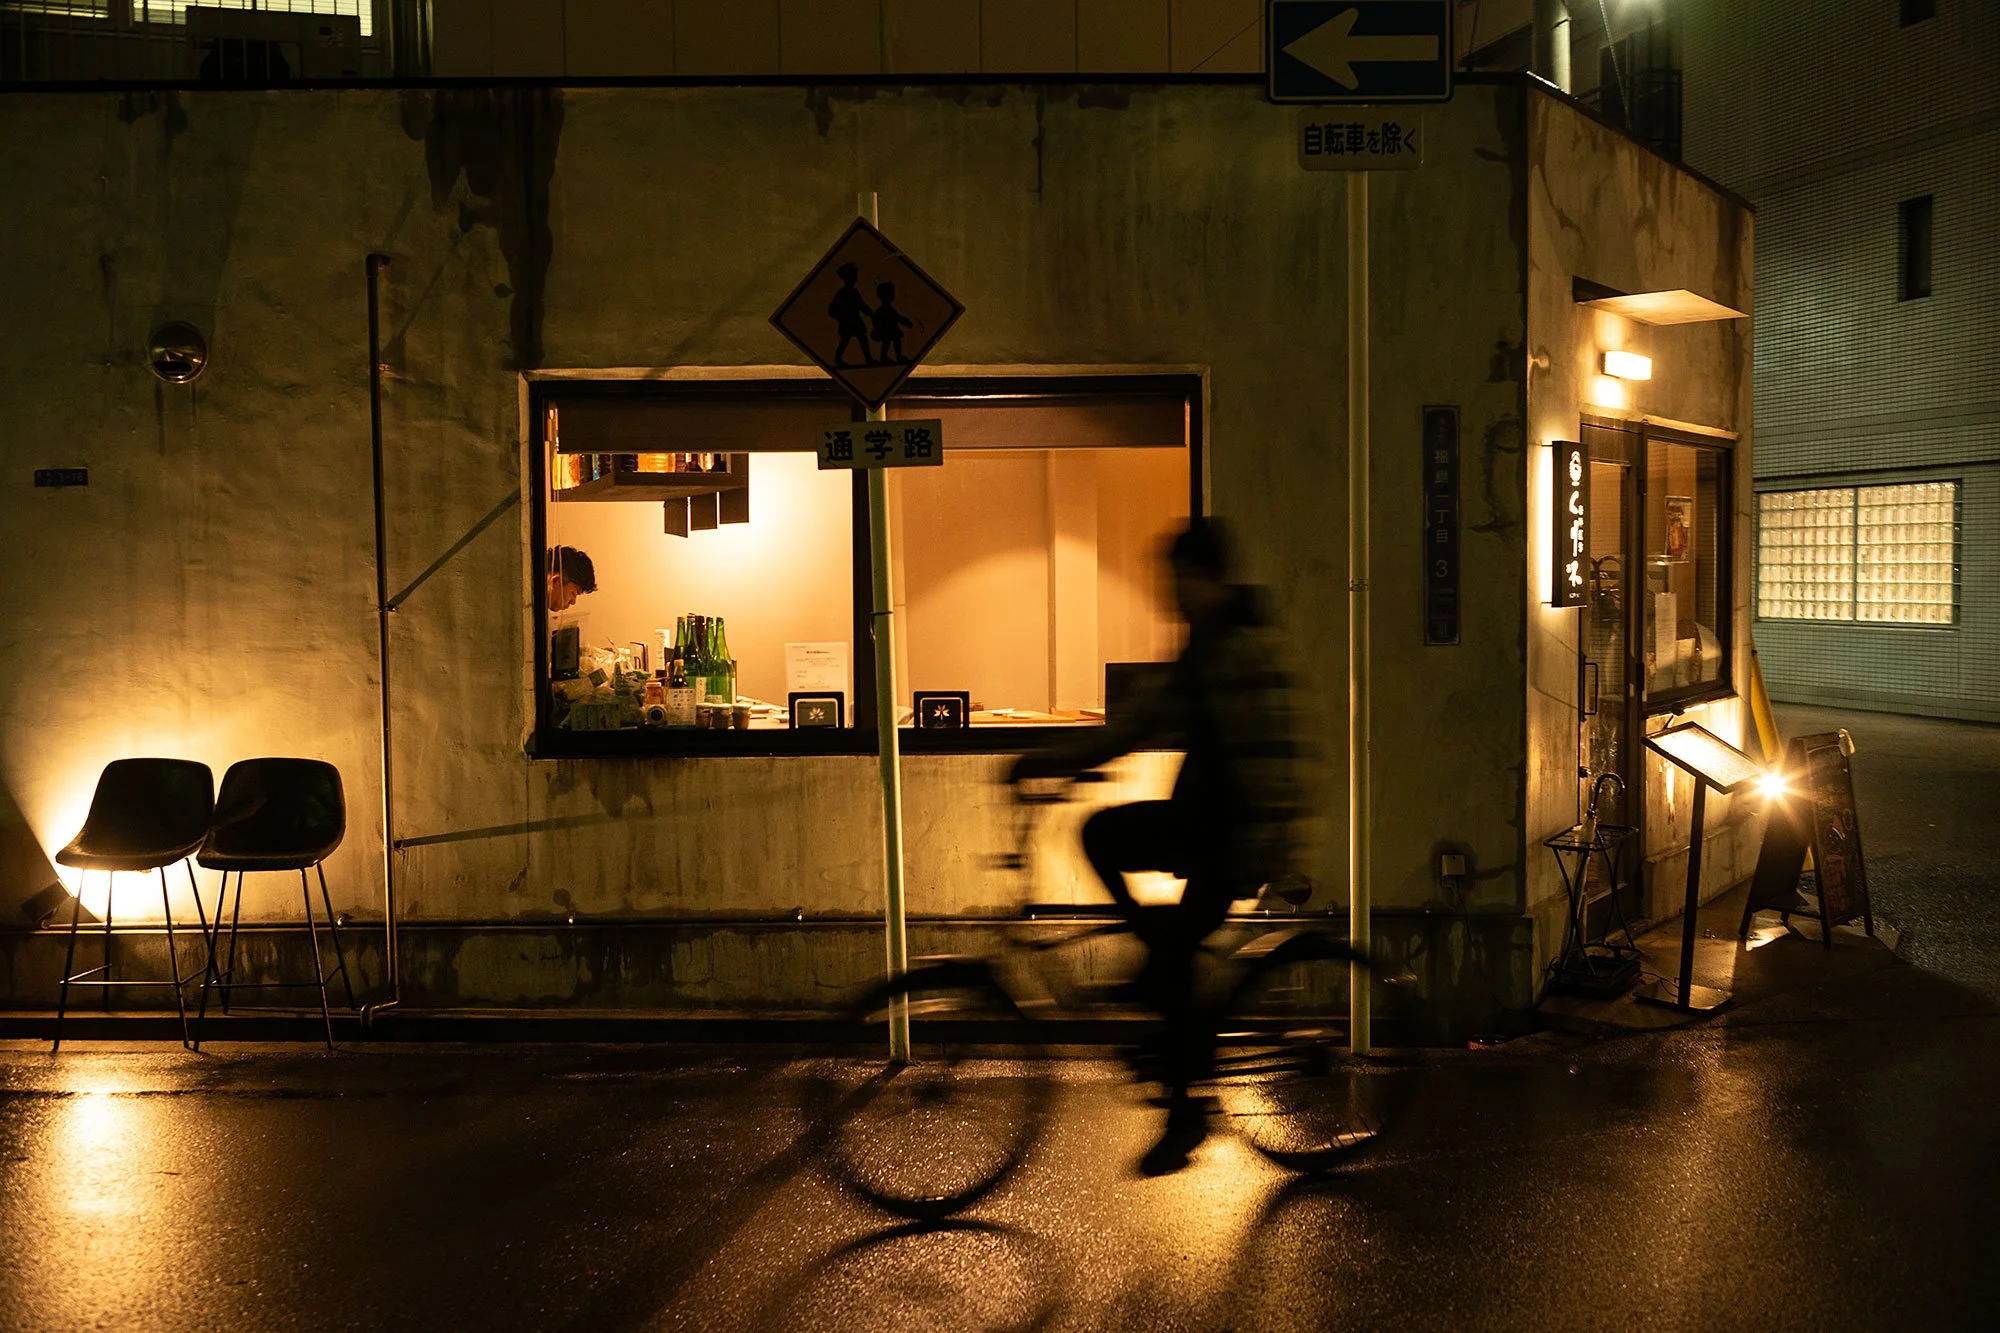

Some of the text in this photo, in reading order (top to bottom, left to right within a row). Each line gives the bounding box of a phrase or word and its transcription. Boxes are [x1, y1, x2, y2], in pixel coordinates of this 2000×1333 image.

[1304, 122, 1416, 155] 自転車を除く
[824, 428, 933, 461] 通学路
